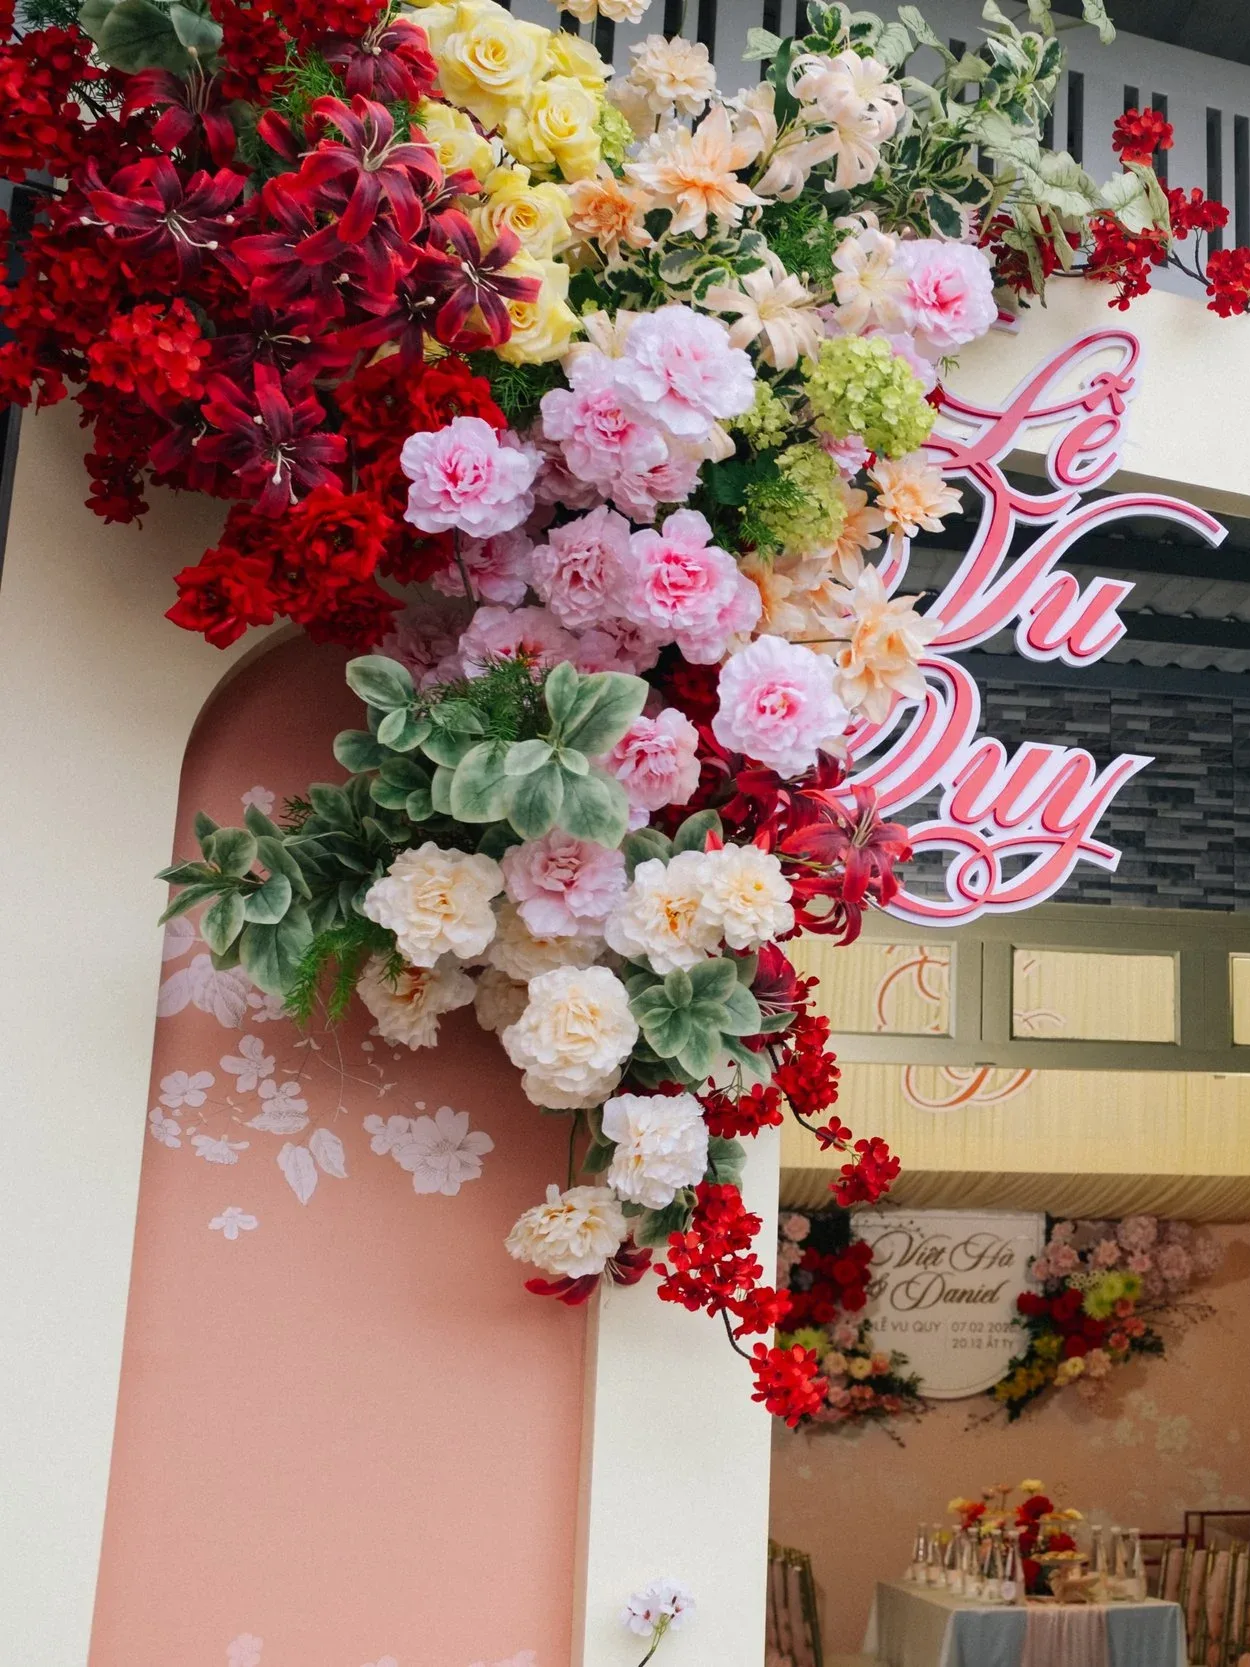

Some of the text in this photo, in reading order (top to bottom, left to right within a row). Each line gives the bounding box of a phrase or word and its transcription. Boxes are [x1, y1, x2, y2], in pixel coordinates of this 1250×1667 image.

[869, 1229, 1034, 1272] Việt Hà
[890, 1271, 1011, 1312] Daniel
[891, 1321, 908, 1333] VU
[912, 1320, 942, 1334] QUY
